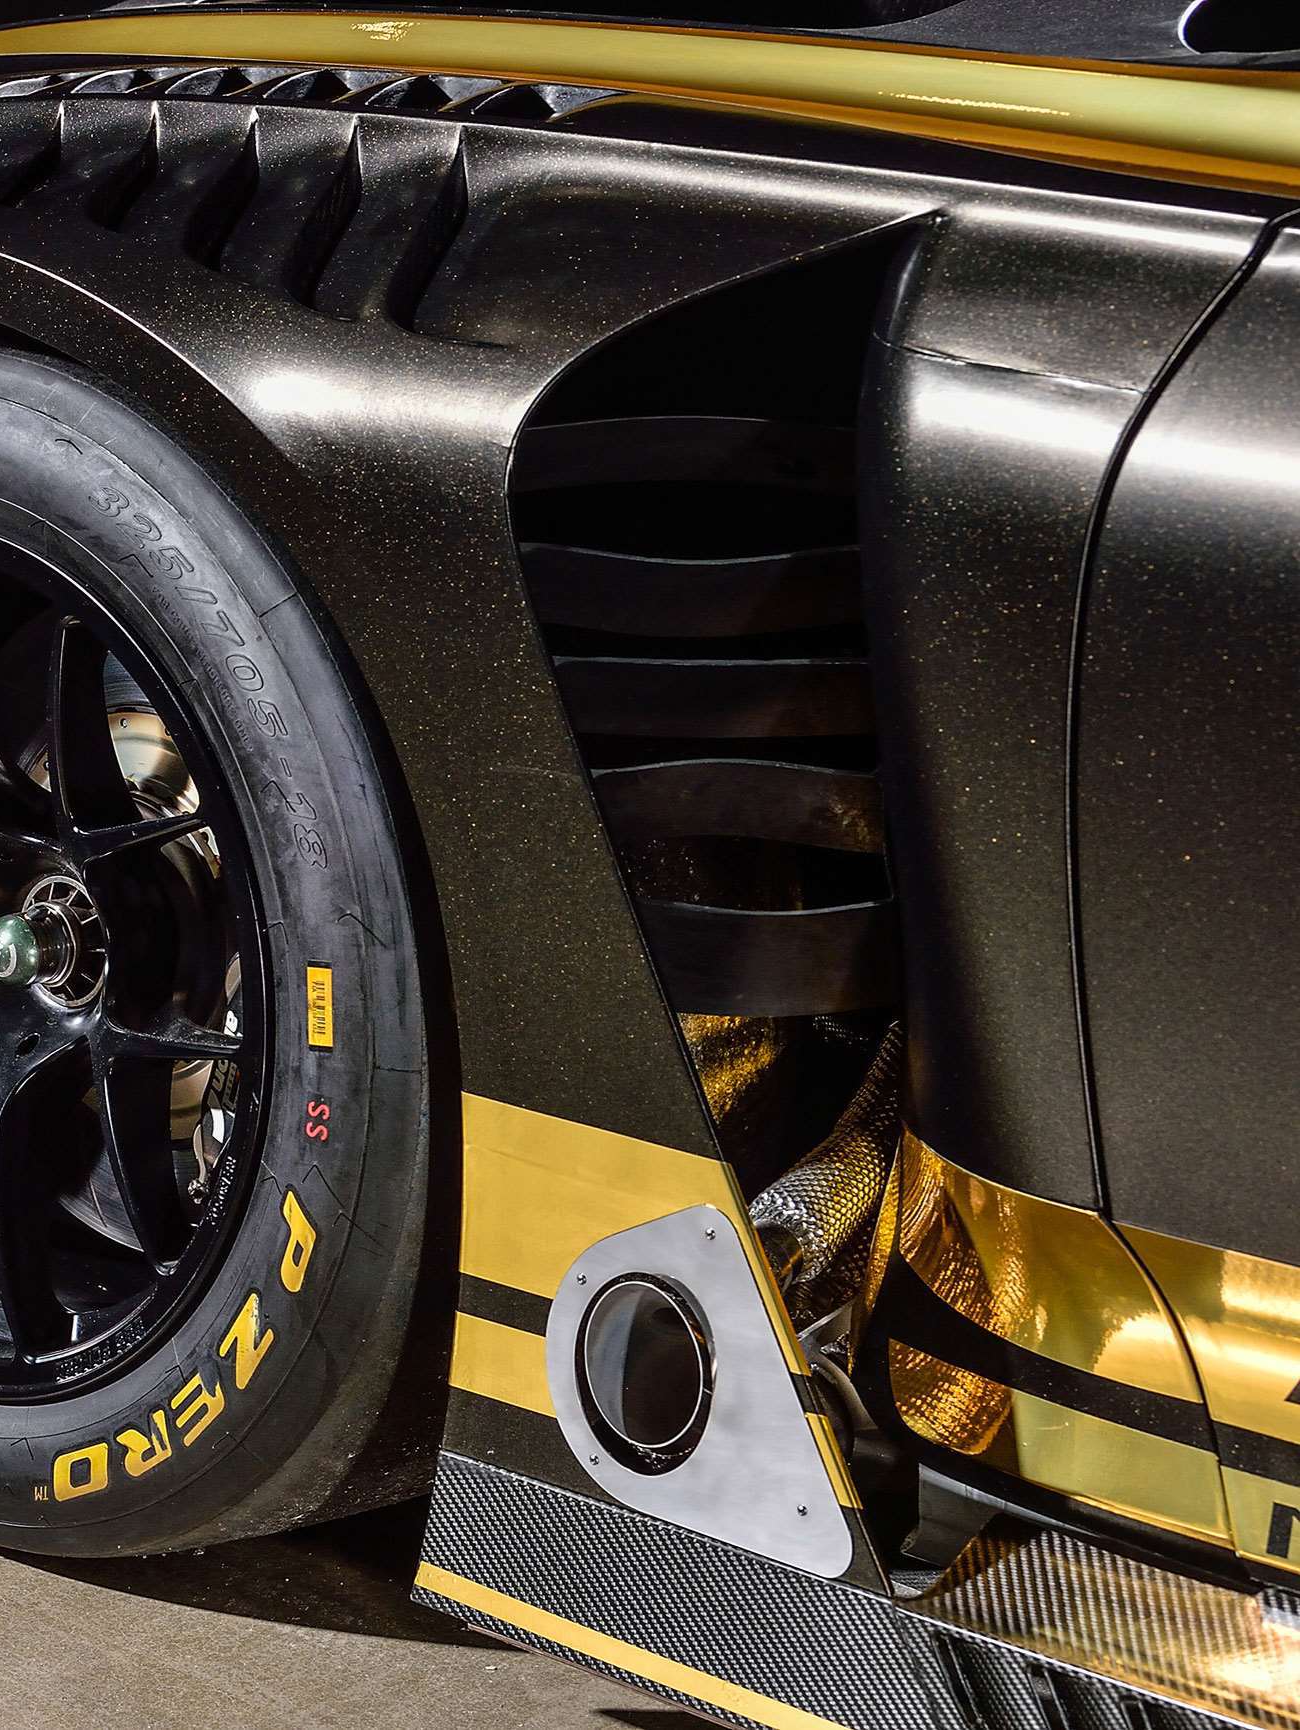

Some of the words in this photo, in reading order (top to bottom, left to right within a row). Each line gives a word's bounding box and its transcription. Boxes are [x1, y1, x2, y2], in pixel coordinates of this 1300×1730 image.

[305, 1101, 331, 1141] SS
[280, 1189, 317, 1293] P
[53, 1292, 275, 1502] ZERO
